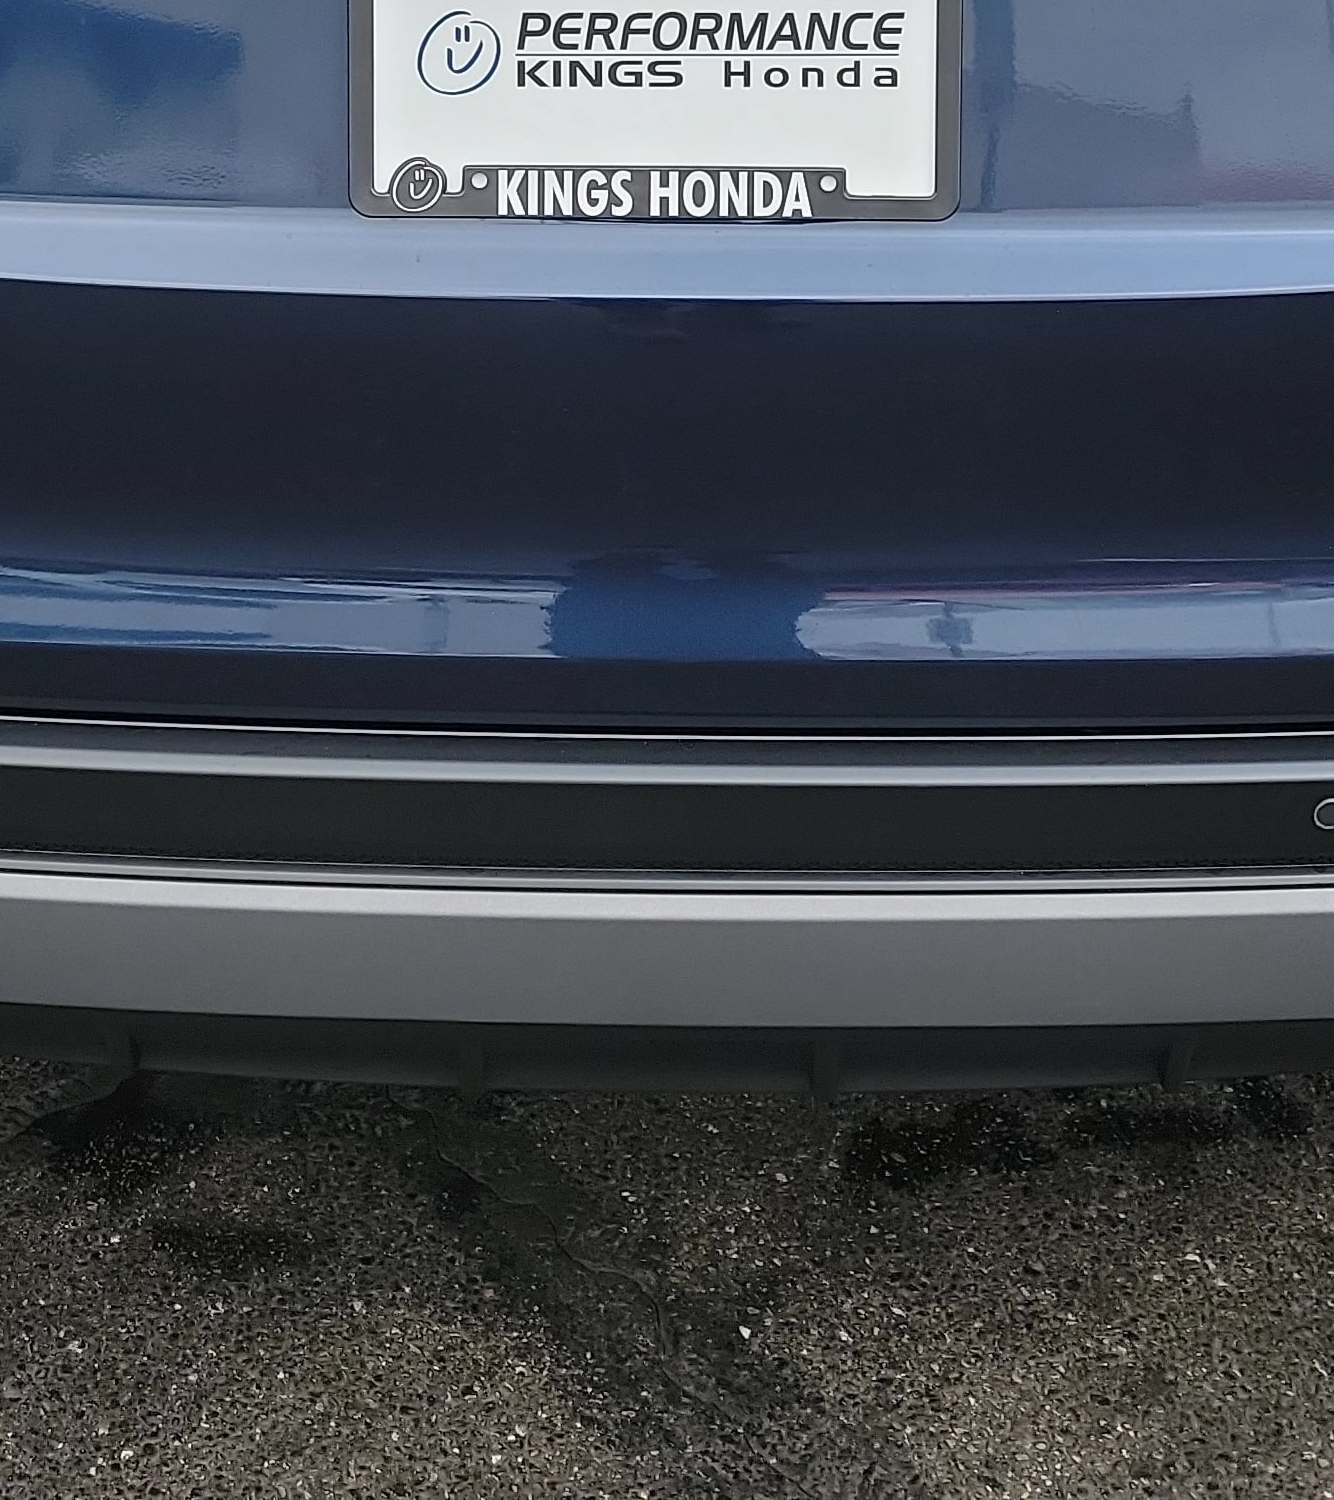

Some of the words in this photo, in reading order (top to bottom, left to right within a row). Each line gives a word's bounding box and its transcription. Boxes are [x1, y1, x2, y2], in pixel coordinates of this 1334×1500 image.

[516, 11, 905, 51] PERFORMANCE
[516, 60, 684, 88] KINGS
[723, 60, 899, 88] Honda
[497, 168, 633, 217] KINGS
[649, 170, 813, 218] HONDA
